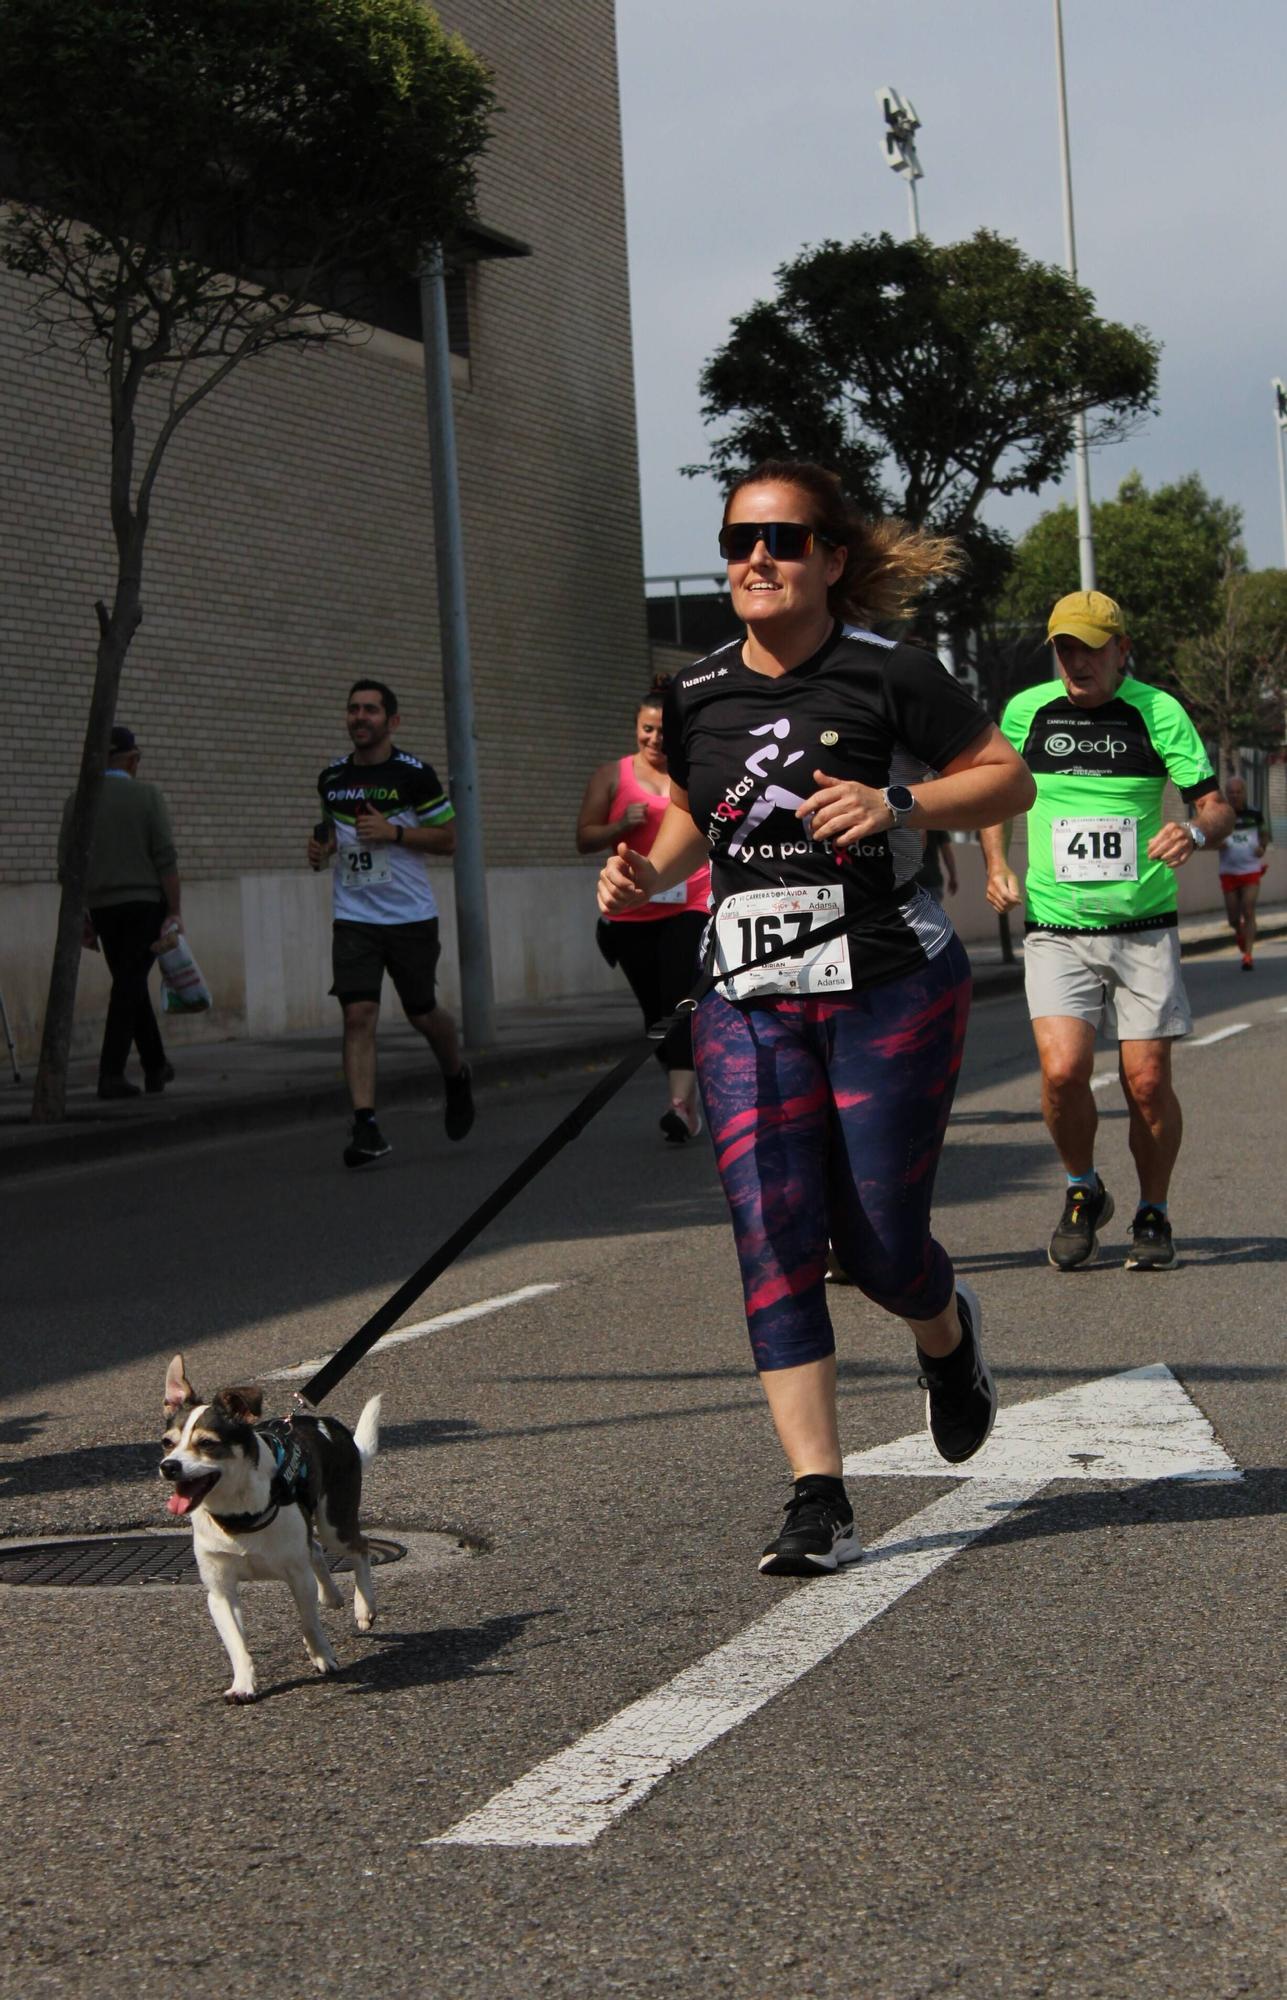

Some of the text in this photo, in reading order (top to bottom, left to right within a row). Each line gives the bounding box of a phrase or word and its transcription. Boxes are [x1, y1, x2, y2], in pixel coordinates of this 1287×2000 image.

[682, 671, 715, 689] luanvi
[1077, 733, 1127, 759] edp
[741, 845, 755, 864] y
[759, 844, 774, 859] a
[1067, 832, 1121, 859] 418
[348, 852, 372, 872] 29
[808, 902, 838, 910] Adarsa
[737, 912, 813, 964] 167
[817, 979, 846, 987] Adarsa
